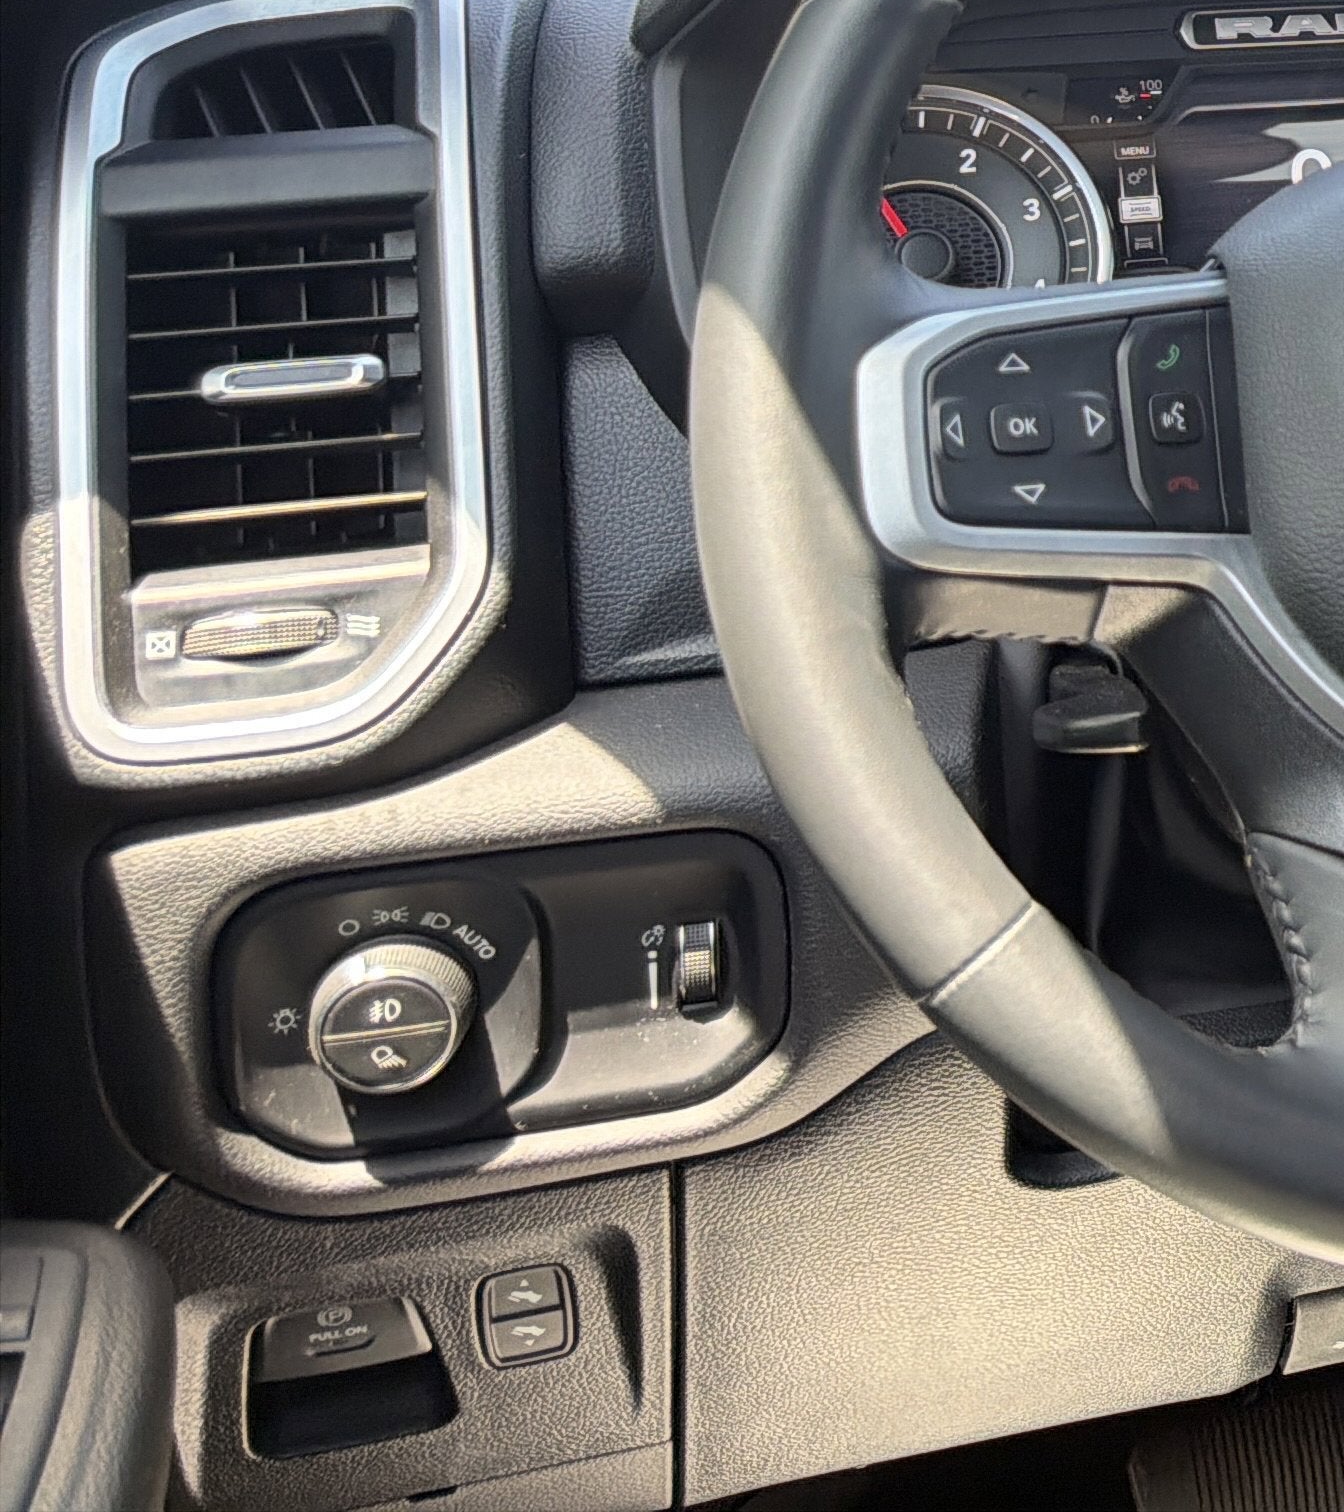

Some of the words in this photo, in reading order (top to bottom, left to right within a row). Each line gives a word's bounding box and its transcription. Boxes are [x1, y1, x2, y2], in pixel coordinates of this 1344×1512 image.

[1139, 79, 1162, 91] 100
[959, 148, 977, 173] 2
[1121, 146, 1149, 156] MENU
[1022, 198, 1041, 221] 3
[1008, 417, 1039, 436] OK
[452, 923, 496, 961] AUTO
[308, 1330, 343, 1343] PULL
[344, 1324, 368, 1337] ON
